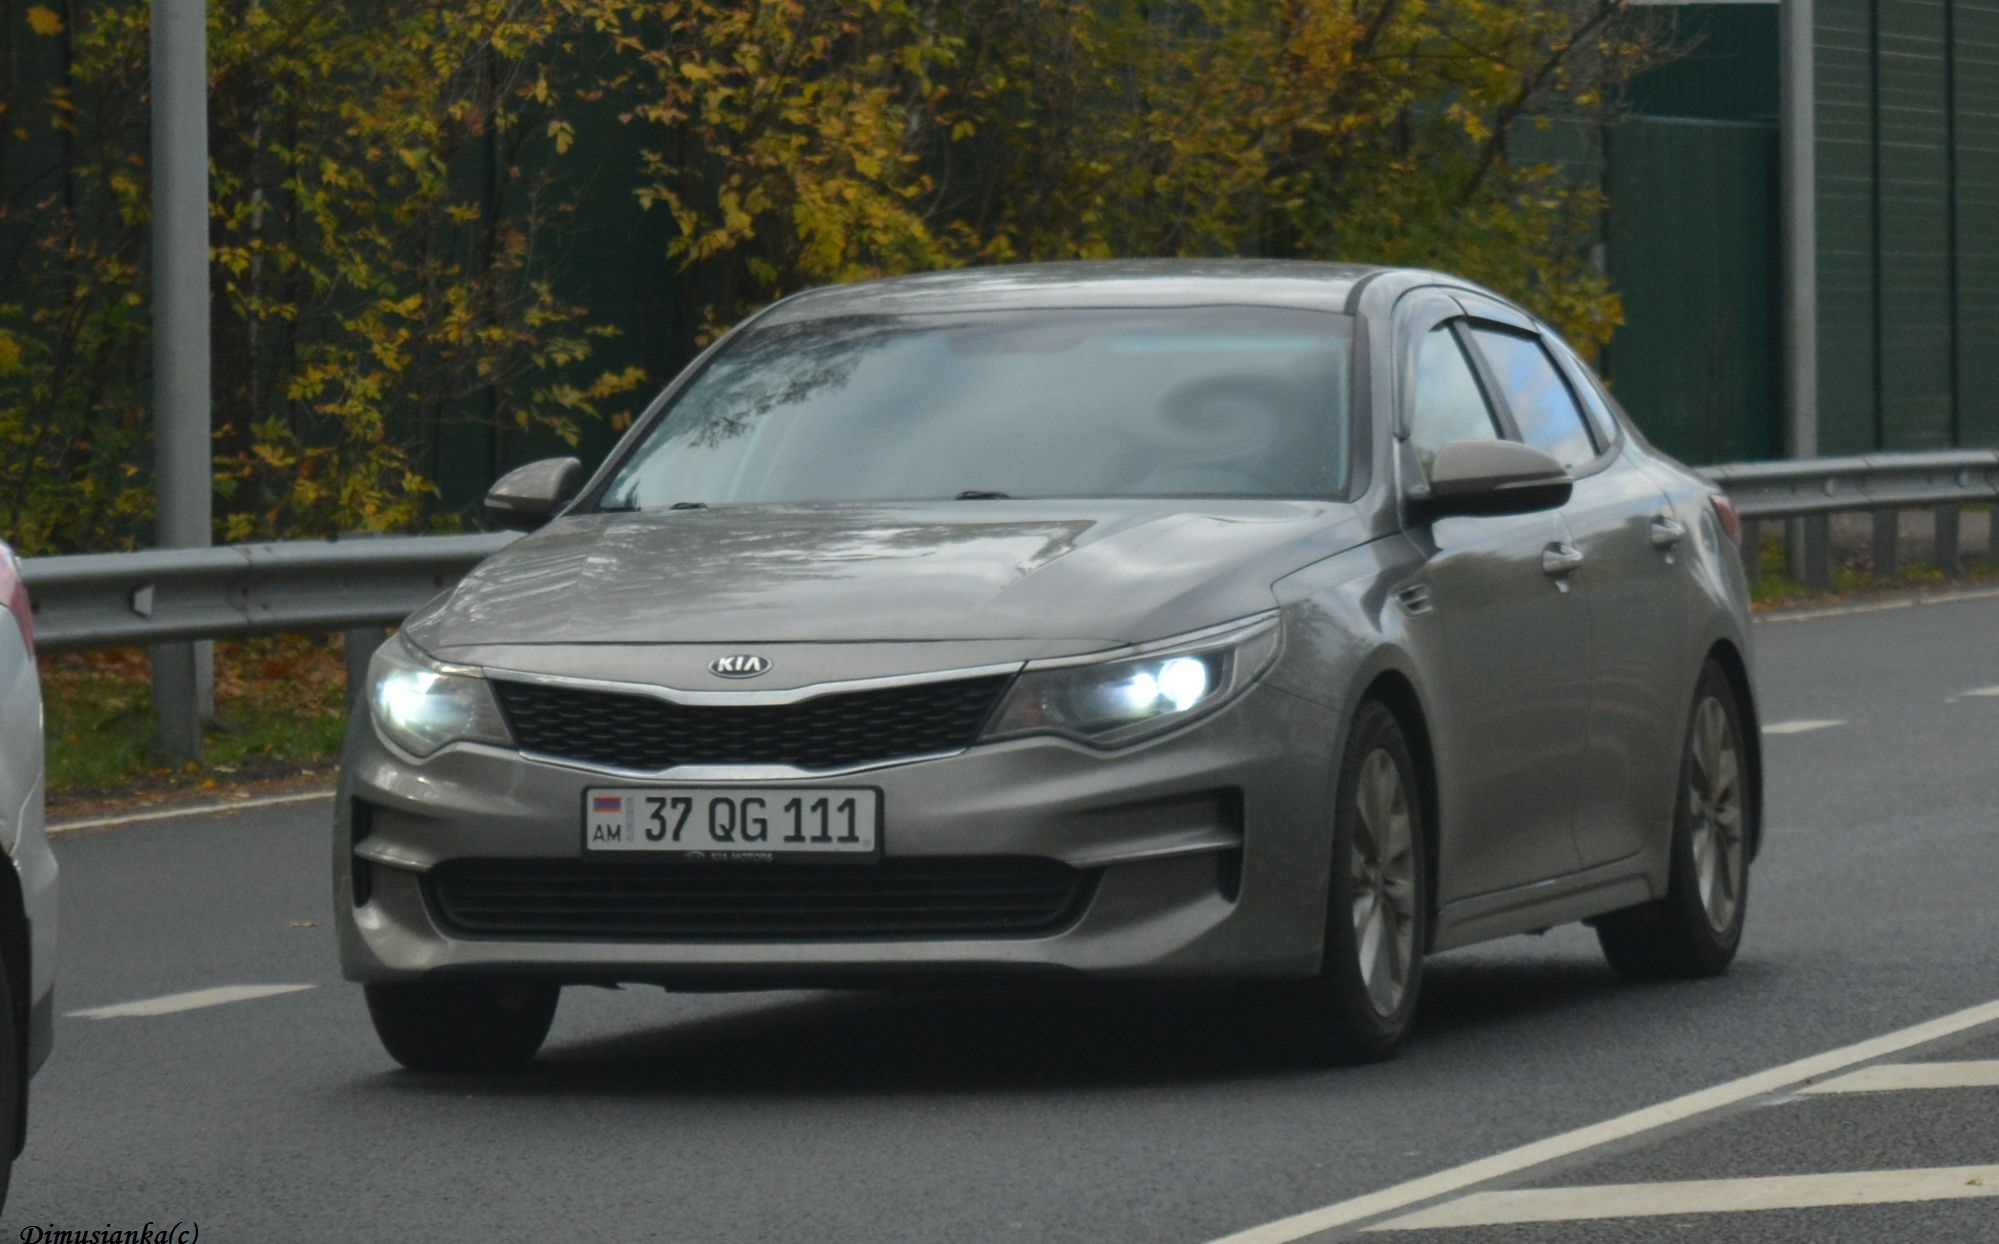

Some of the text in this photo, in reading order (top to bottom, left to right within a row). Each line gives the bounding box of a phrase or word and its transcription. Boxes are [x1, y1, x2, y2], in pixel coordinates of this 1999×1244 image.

[717, 656, 761, 671] KIA
[645, 797, 860, 843] 37 QG 111
[592, 825, 621, 842] AM
